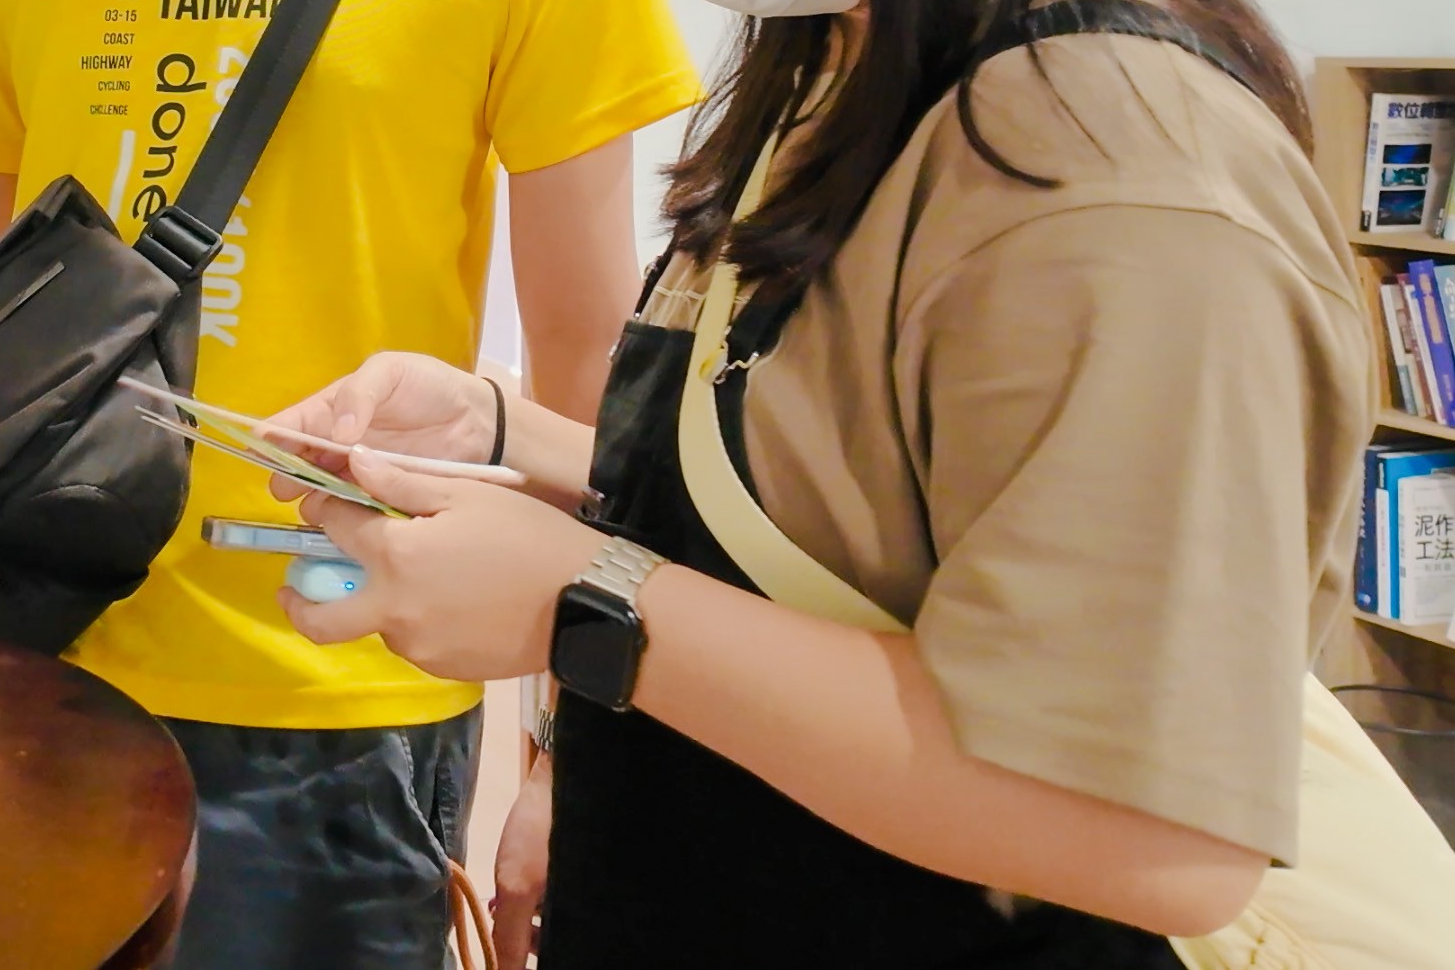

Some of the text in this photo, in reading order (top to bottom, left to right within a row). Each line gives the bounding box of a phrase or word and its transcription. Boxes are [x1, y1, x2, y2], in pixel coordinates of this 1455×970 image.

[104, 9, 138, 22] 03-15
[103, 32, 135, 45] COAST
[81, 55, 133, 71] HIGHWAY
[97, 80, 131, 92] CYCLING
